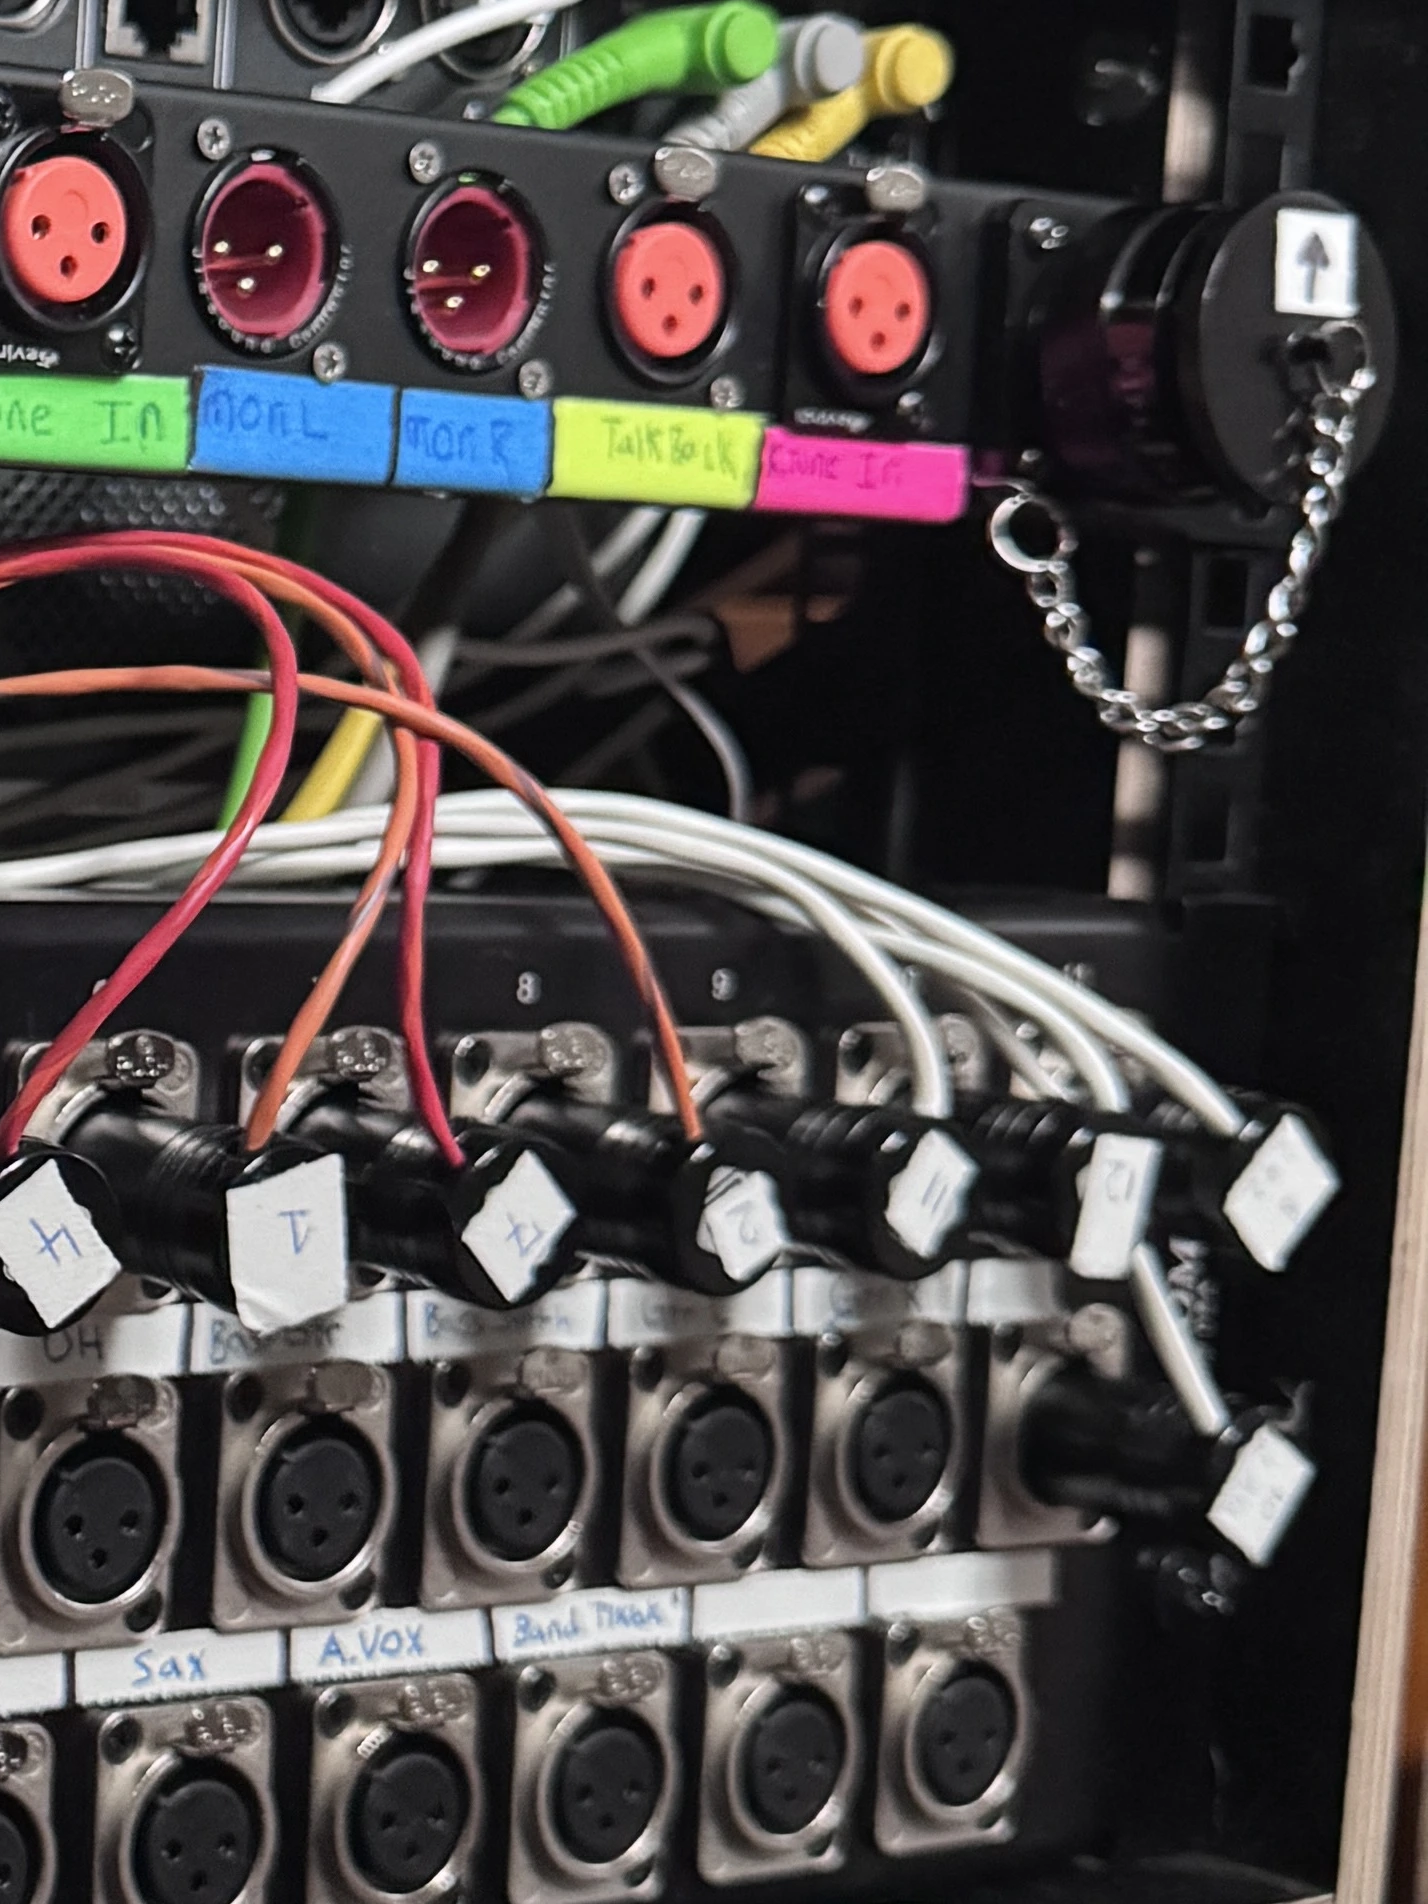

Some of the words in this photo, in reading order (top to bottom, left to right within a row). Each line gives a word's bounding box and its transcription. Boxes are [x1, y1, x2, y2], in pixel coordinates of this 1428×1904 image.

[516, 971, 543, 1005] 8
[27, 1216, 83, 1266] 4
[131, 1648, 208, 1688] Sax
